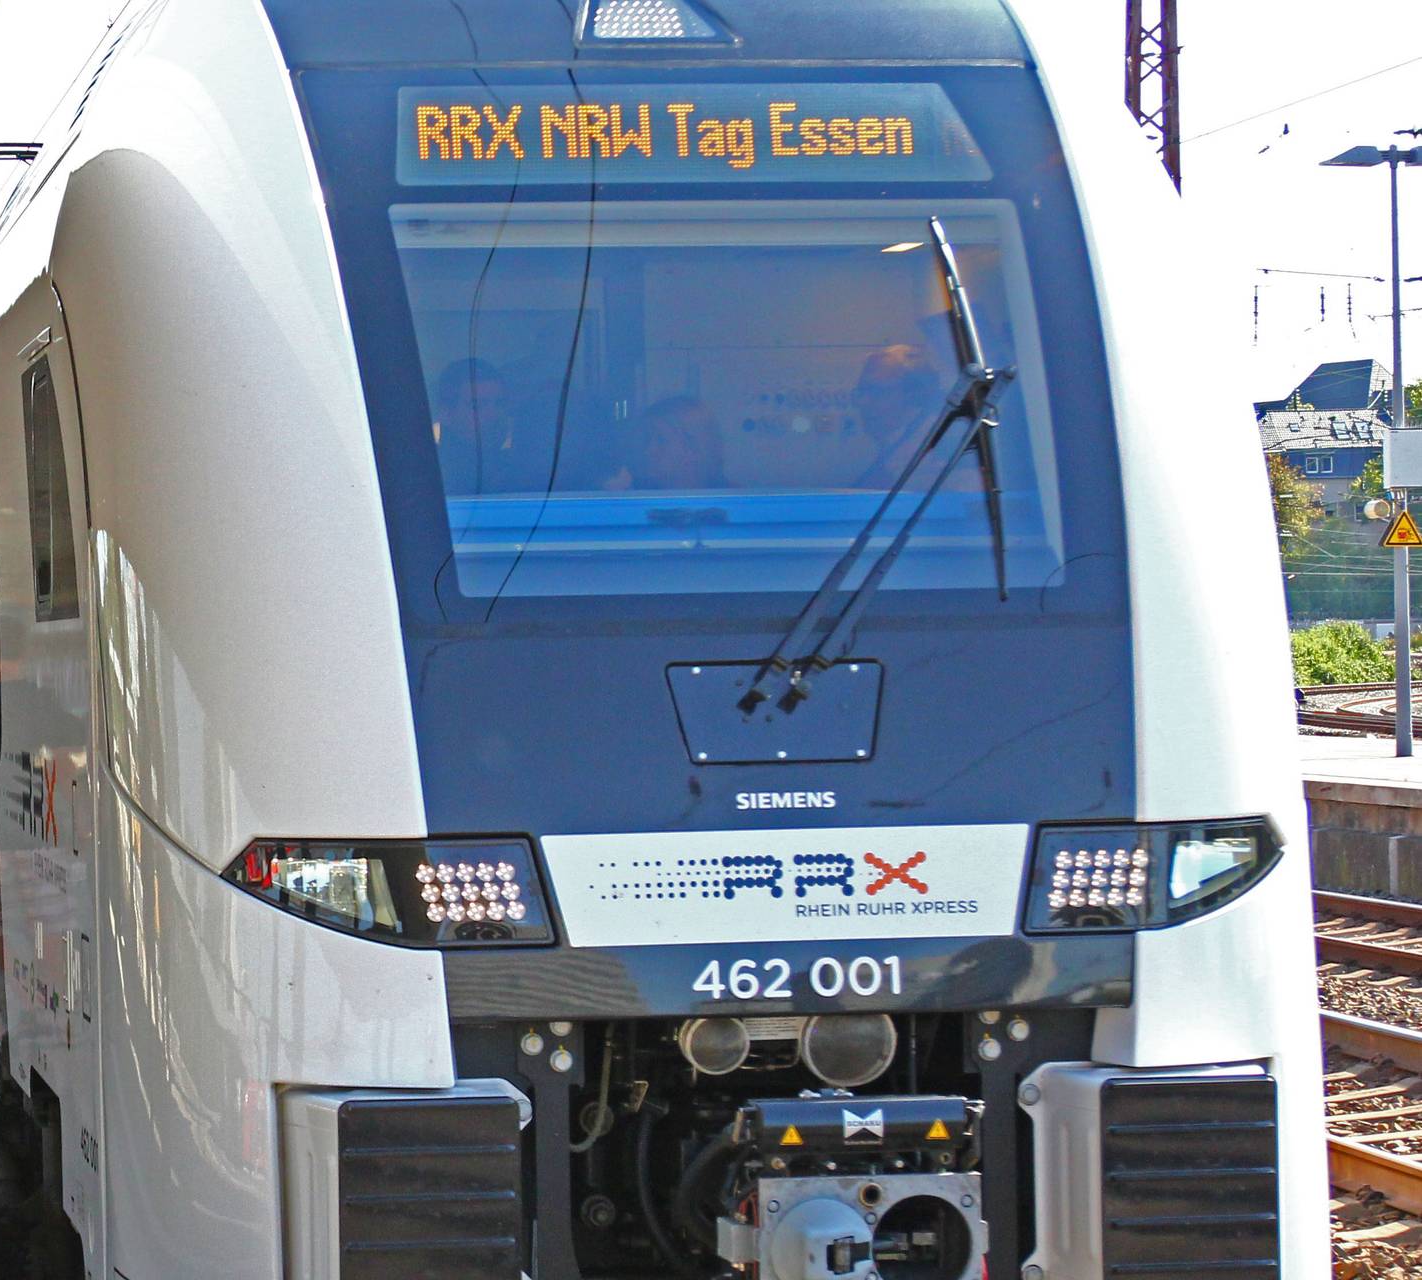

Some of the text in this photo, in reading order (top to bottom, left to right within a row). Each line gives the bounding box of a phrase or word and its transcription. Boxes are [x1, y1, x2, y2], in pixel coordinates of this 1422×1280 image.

[416, 102, 914, 169] RRX NRW Tag Essen
[735, 790, 836, 810] SIEMENS
[721, 851, 929, 898] RRX
[795, 899, 979, 918] RHEIN RUHR XPRESS
[691, 954, 902, 1000] 462 001
